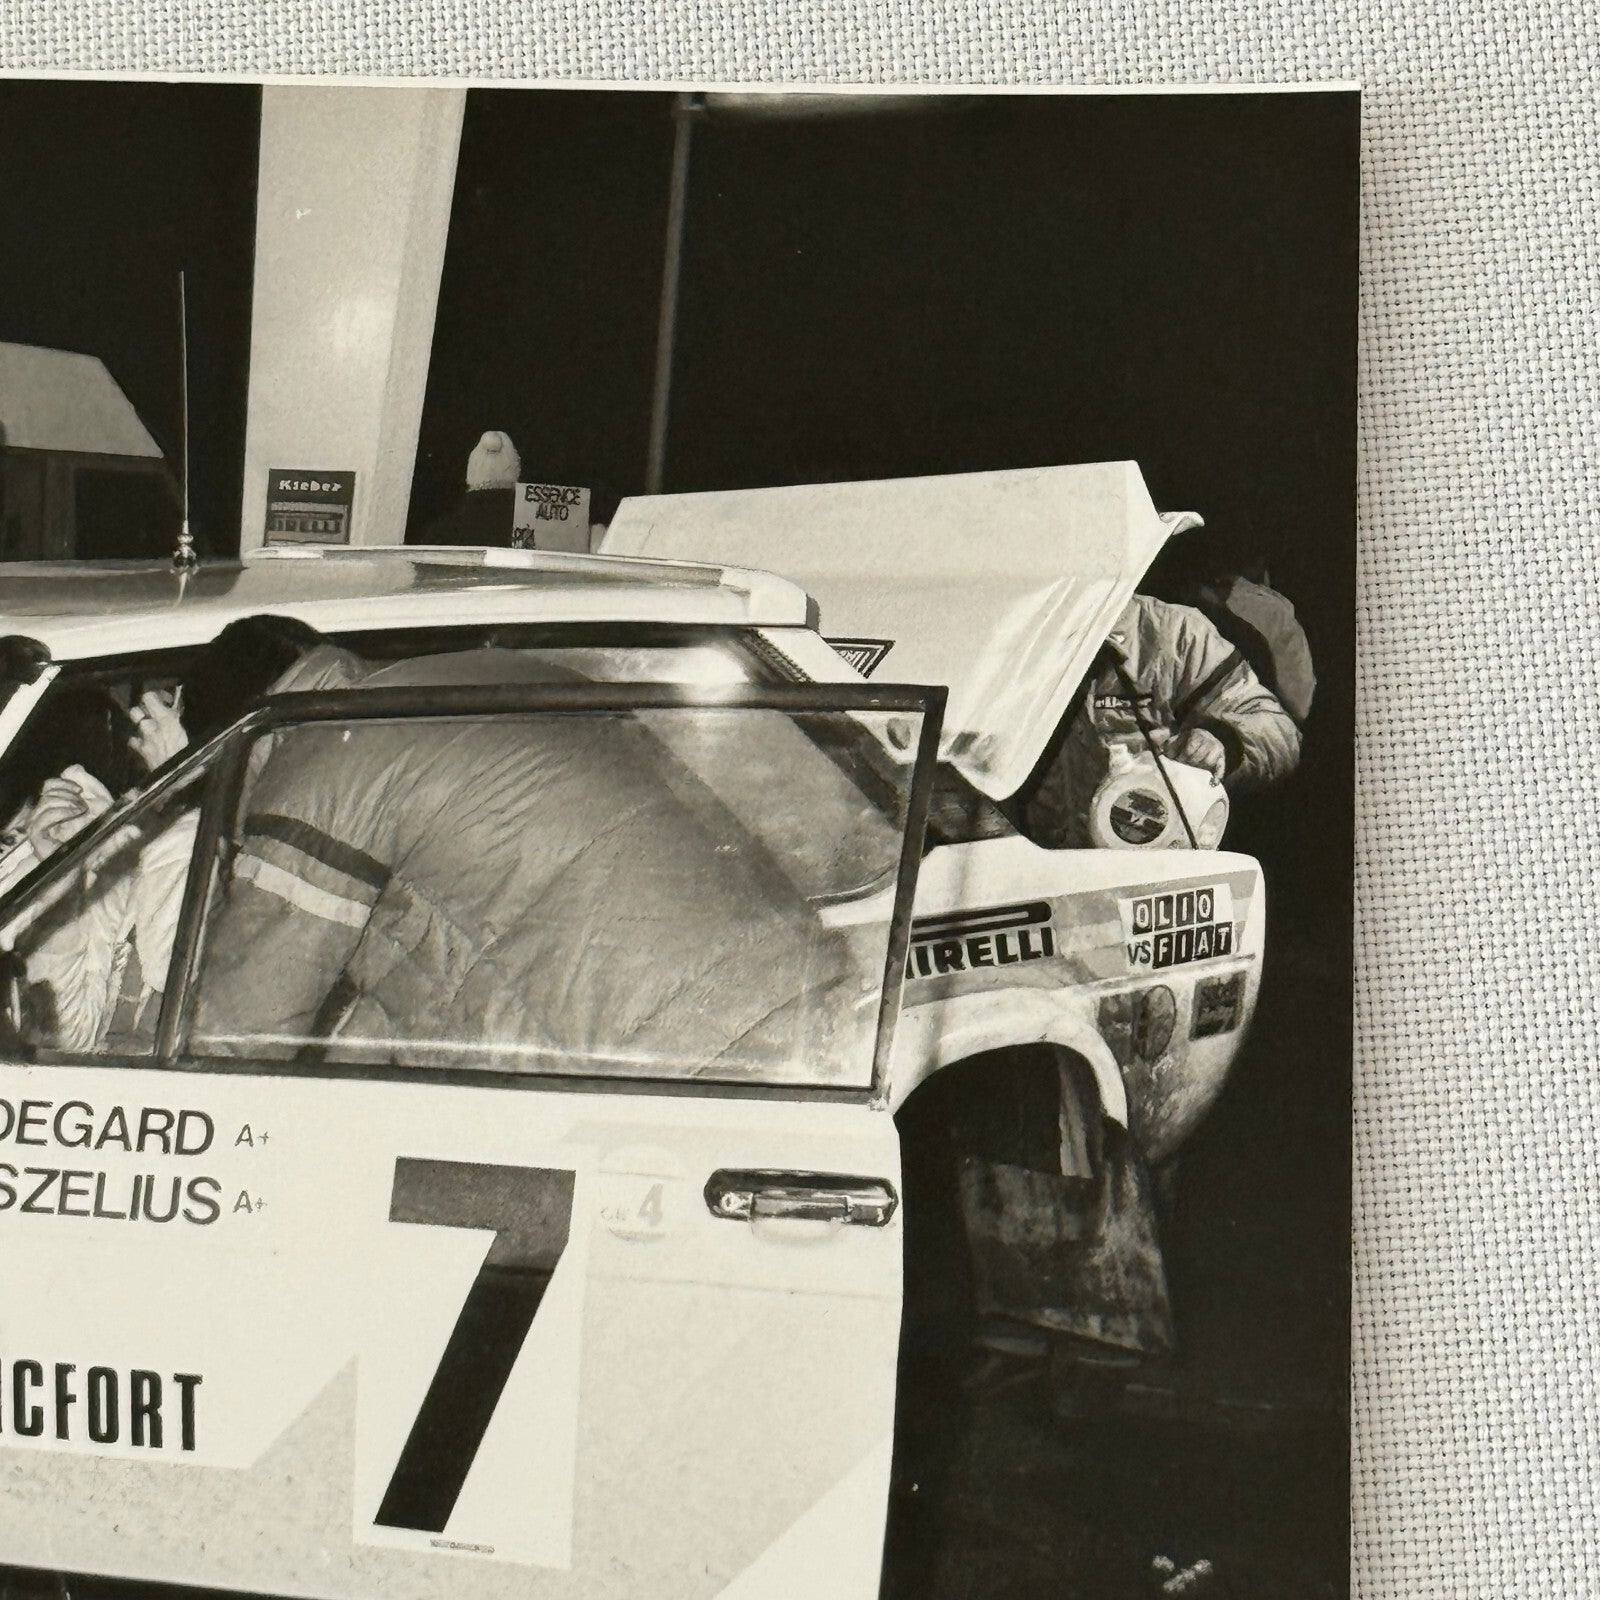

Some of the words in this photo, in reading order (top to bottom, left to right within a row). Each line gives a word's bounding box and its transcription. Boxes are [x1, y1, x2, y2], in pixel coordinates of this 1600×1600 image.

[535, 503, 569, 521] AUTO
[1134, 889, 1213, 931] OLIO
[904, 903, 1053, 979] IRELLI
[1156, 925, 1231, 965] FIAT
[373, 1156, 576, 1533] 7
[0, 1358, 203, 1451] CFORT
